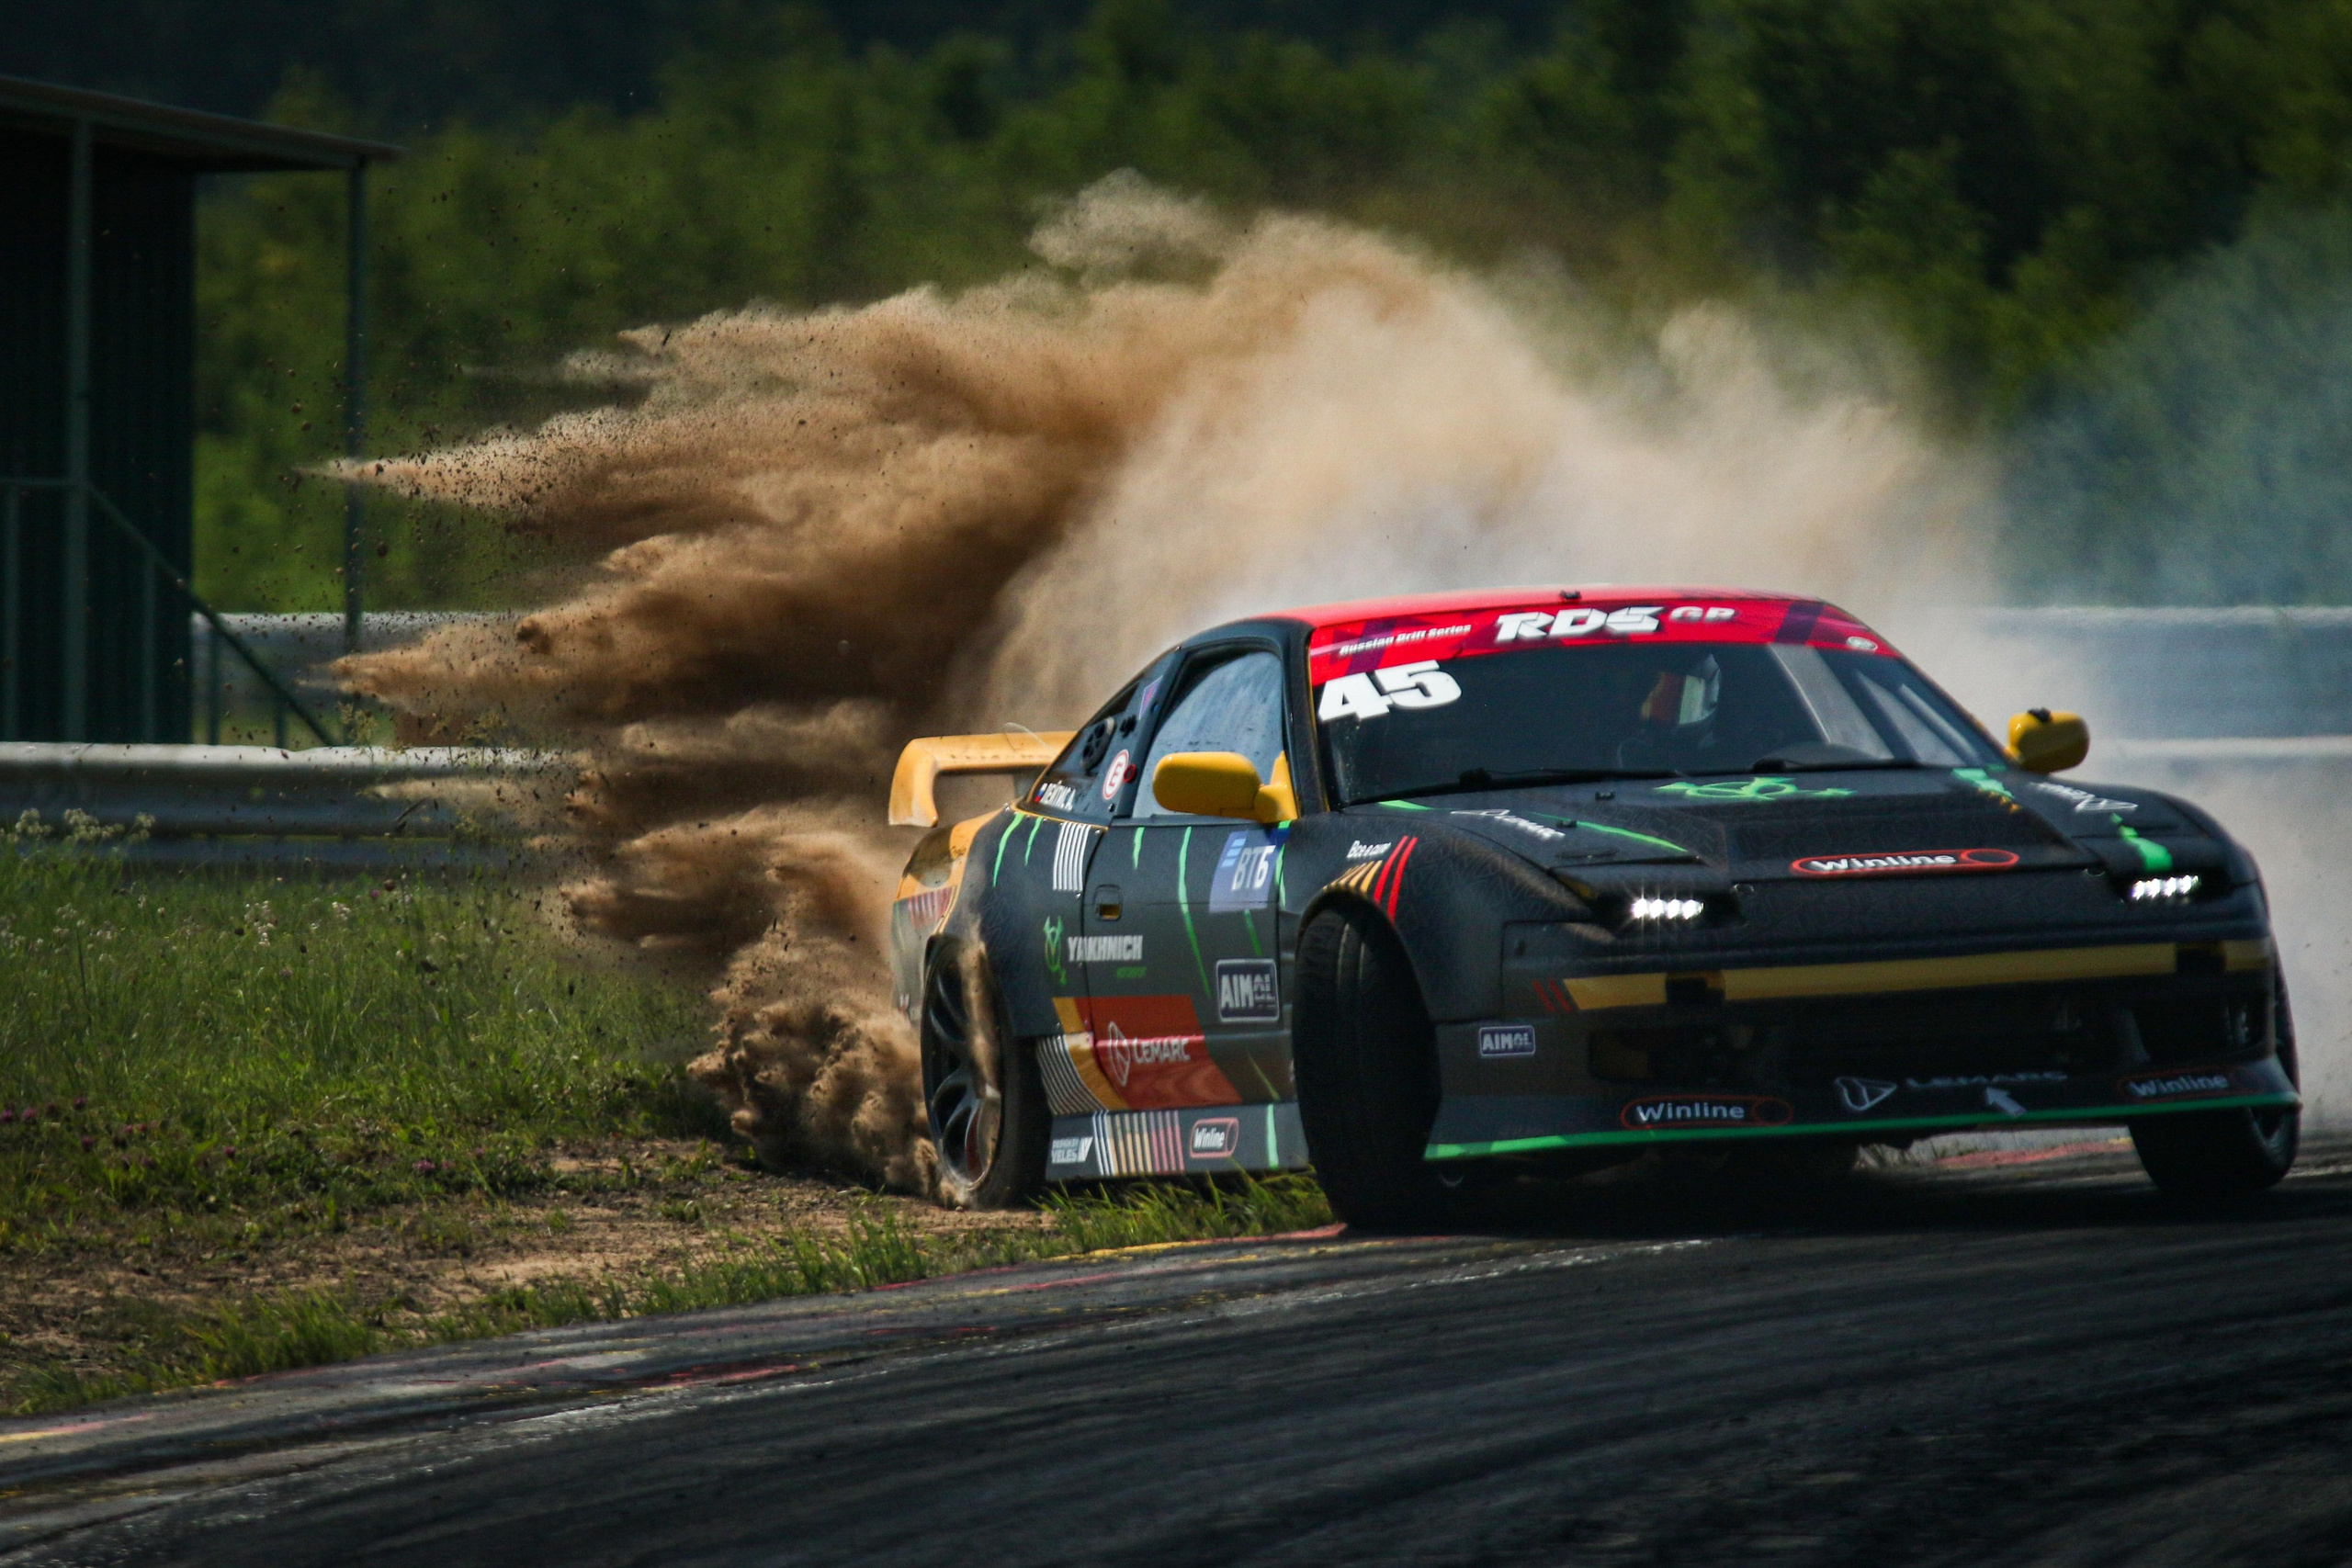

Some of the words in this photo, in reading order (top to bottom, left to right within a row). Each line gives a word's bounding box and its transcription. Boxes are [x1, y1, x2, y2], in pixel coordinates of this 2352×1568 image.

[1494, 606, 1664, 642] RDS
[1668, 605, 1736, 621] GP
[1339, 635, 1395, 656] Russian
[1395, 629, 1427, 643] Drift
[1427, 624, 1472, 639] Series
[1317, 659, 1463, 723] 45
[1108, 762, 1123, 787] E
[1232, 845, 1276, 891] ВТБ
[1810, 852, 1957, 871] Winline
[1068, 935, 1143, 963] YAKHNICH
[1133, 1038, 1191, 1065] LEMARC
[2128, 1074, 2230, 1097] Winline
[1636, 1102, 1745, 1122] Winline
[1194, 1127, 1226, 1149] Winline
